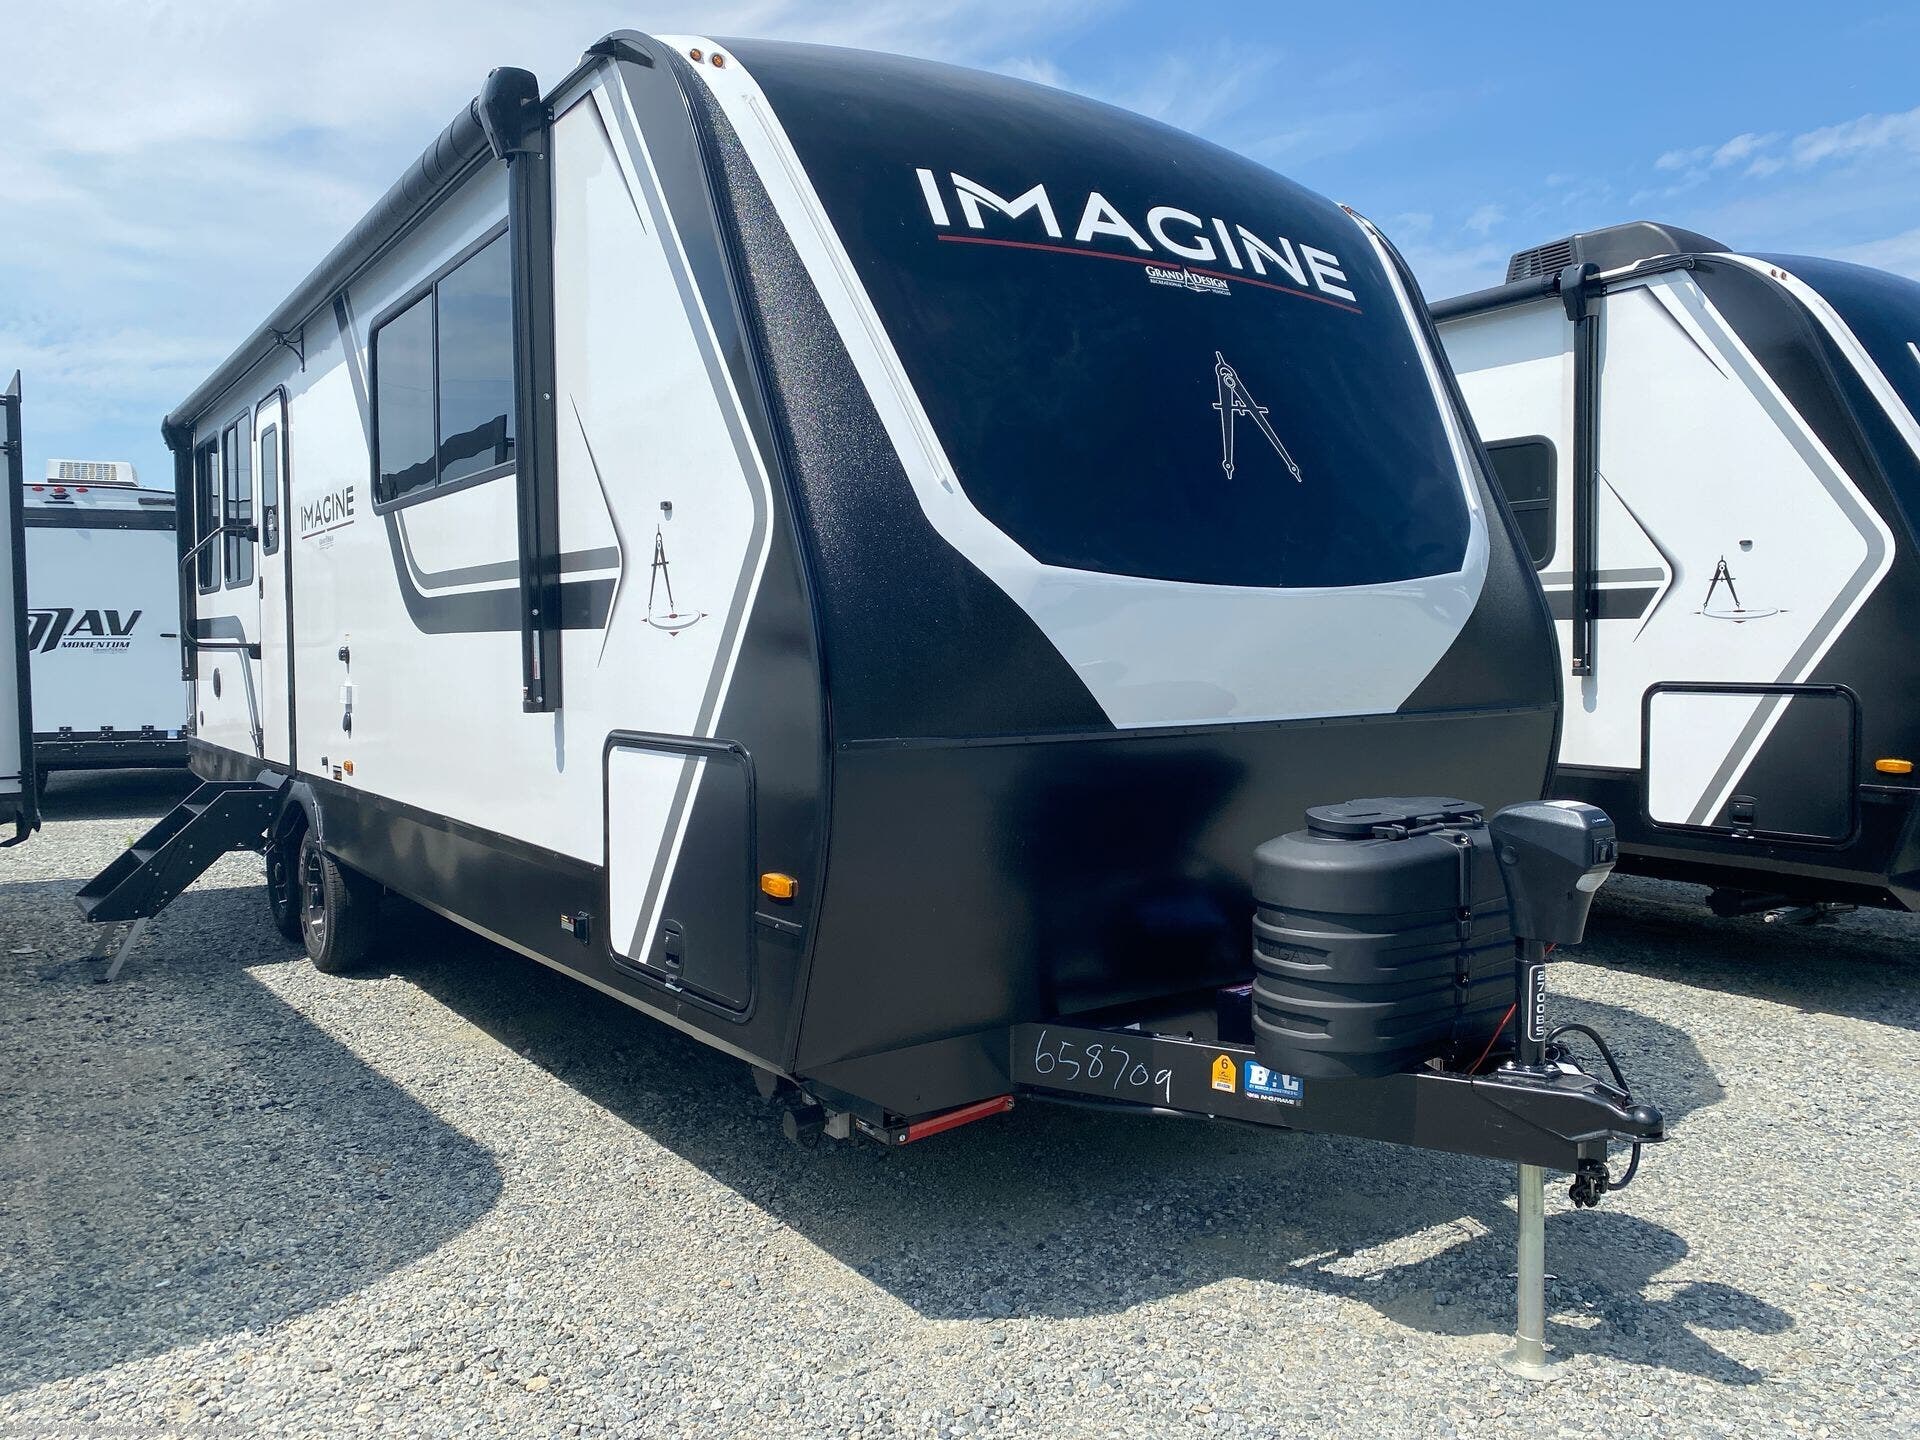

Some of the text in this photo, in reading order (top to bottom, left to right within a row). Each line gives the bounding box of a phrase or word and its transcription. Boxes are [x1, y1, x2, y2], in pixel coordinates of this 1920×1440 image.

[915, 168, 1356, 301] IMAGINE
[1145, 265, 1228, 289] GRAND DESIGN
[300, 485, 355, 532] IMAGINE
[1535, 970, 1545, 1036] 2700BS
[1034, 1030, 1174, 1104] 658709
[1221, 1058, 1228, 1069] 6
